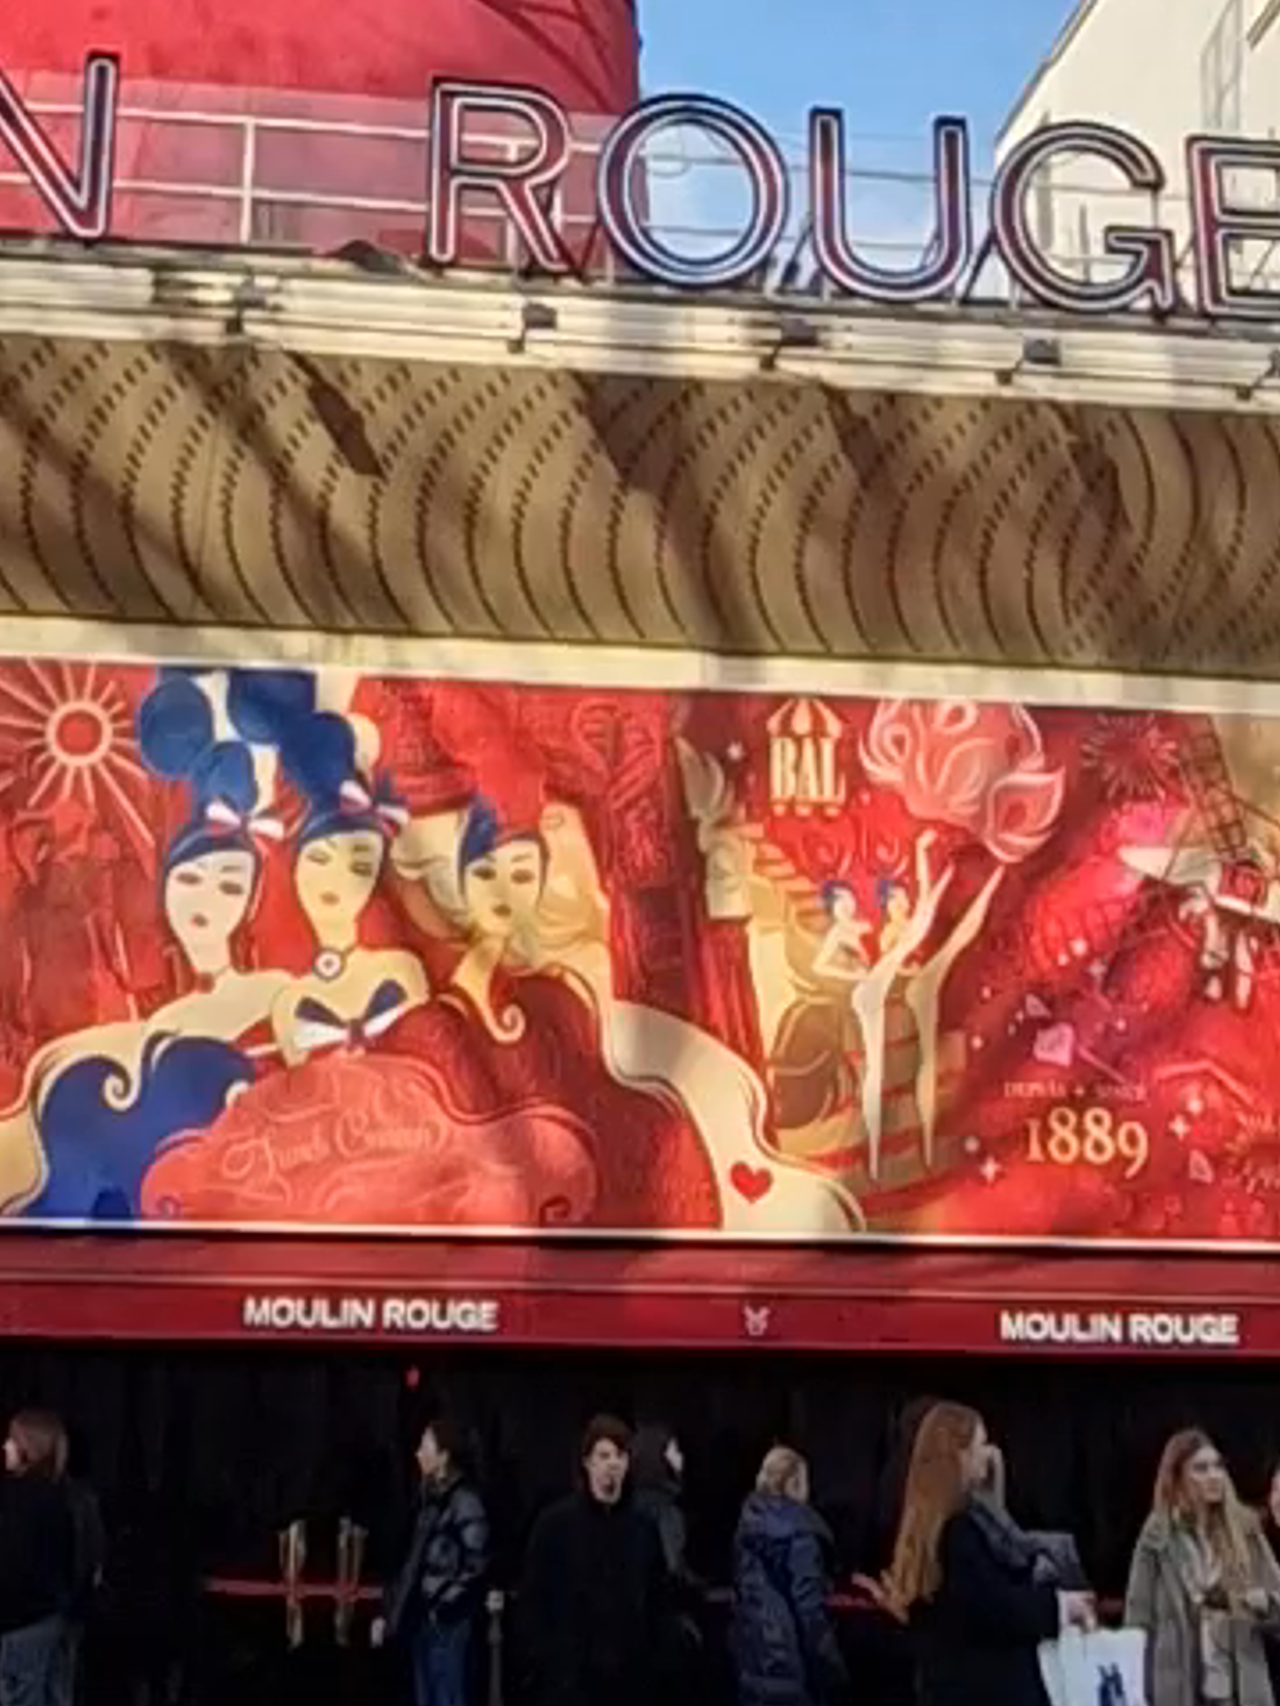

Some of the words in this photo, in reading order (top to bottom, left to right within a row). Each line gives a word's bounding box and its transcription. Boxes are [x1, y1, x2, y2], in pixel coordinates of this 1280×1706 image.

[771, 736, 846, 807] BAL
[1024, 1106, 1149, 1180] 1889
[243, 1294, 375, 1329] MOULIN
[382, 1297, 500, 1331] ROUGE
[999, 1310, 1122, 1344] MOULIN
[1128, 1313, 1240, 1345] ROUGE
